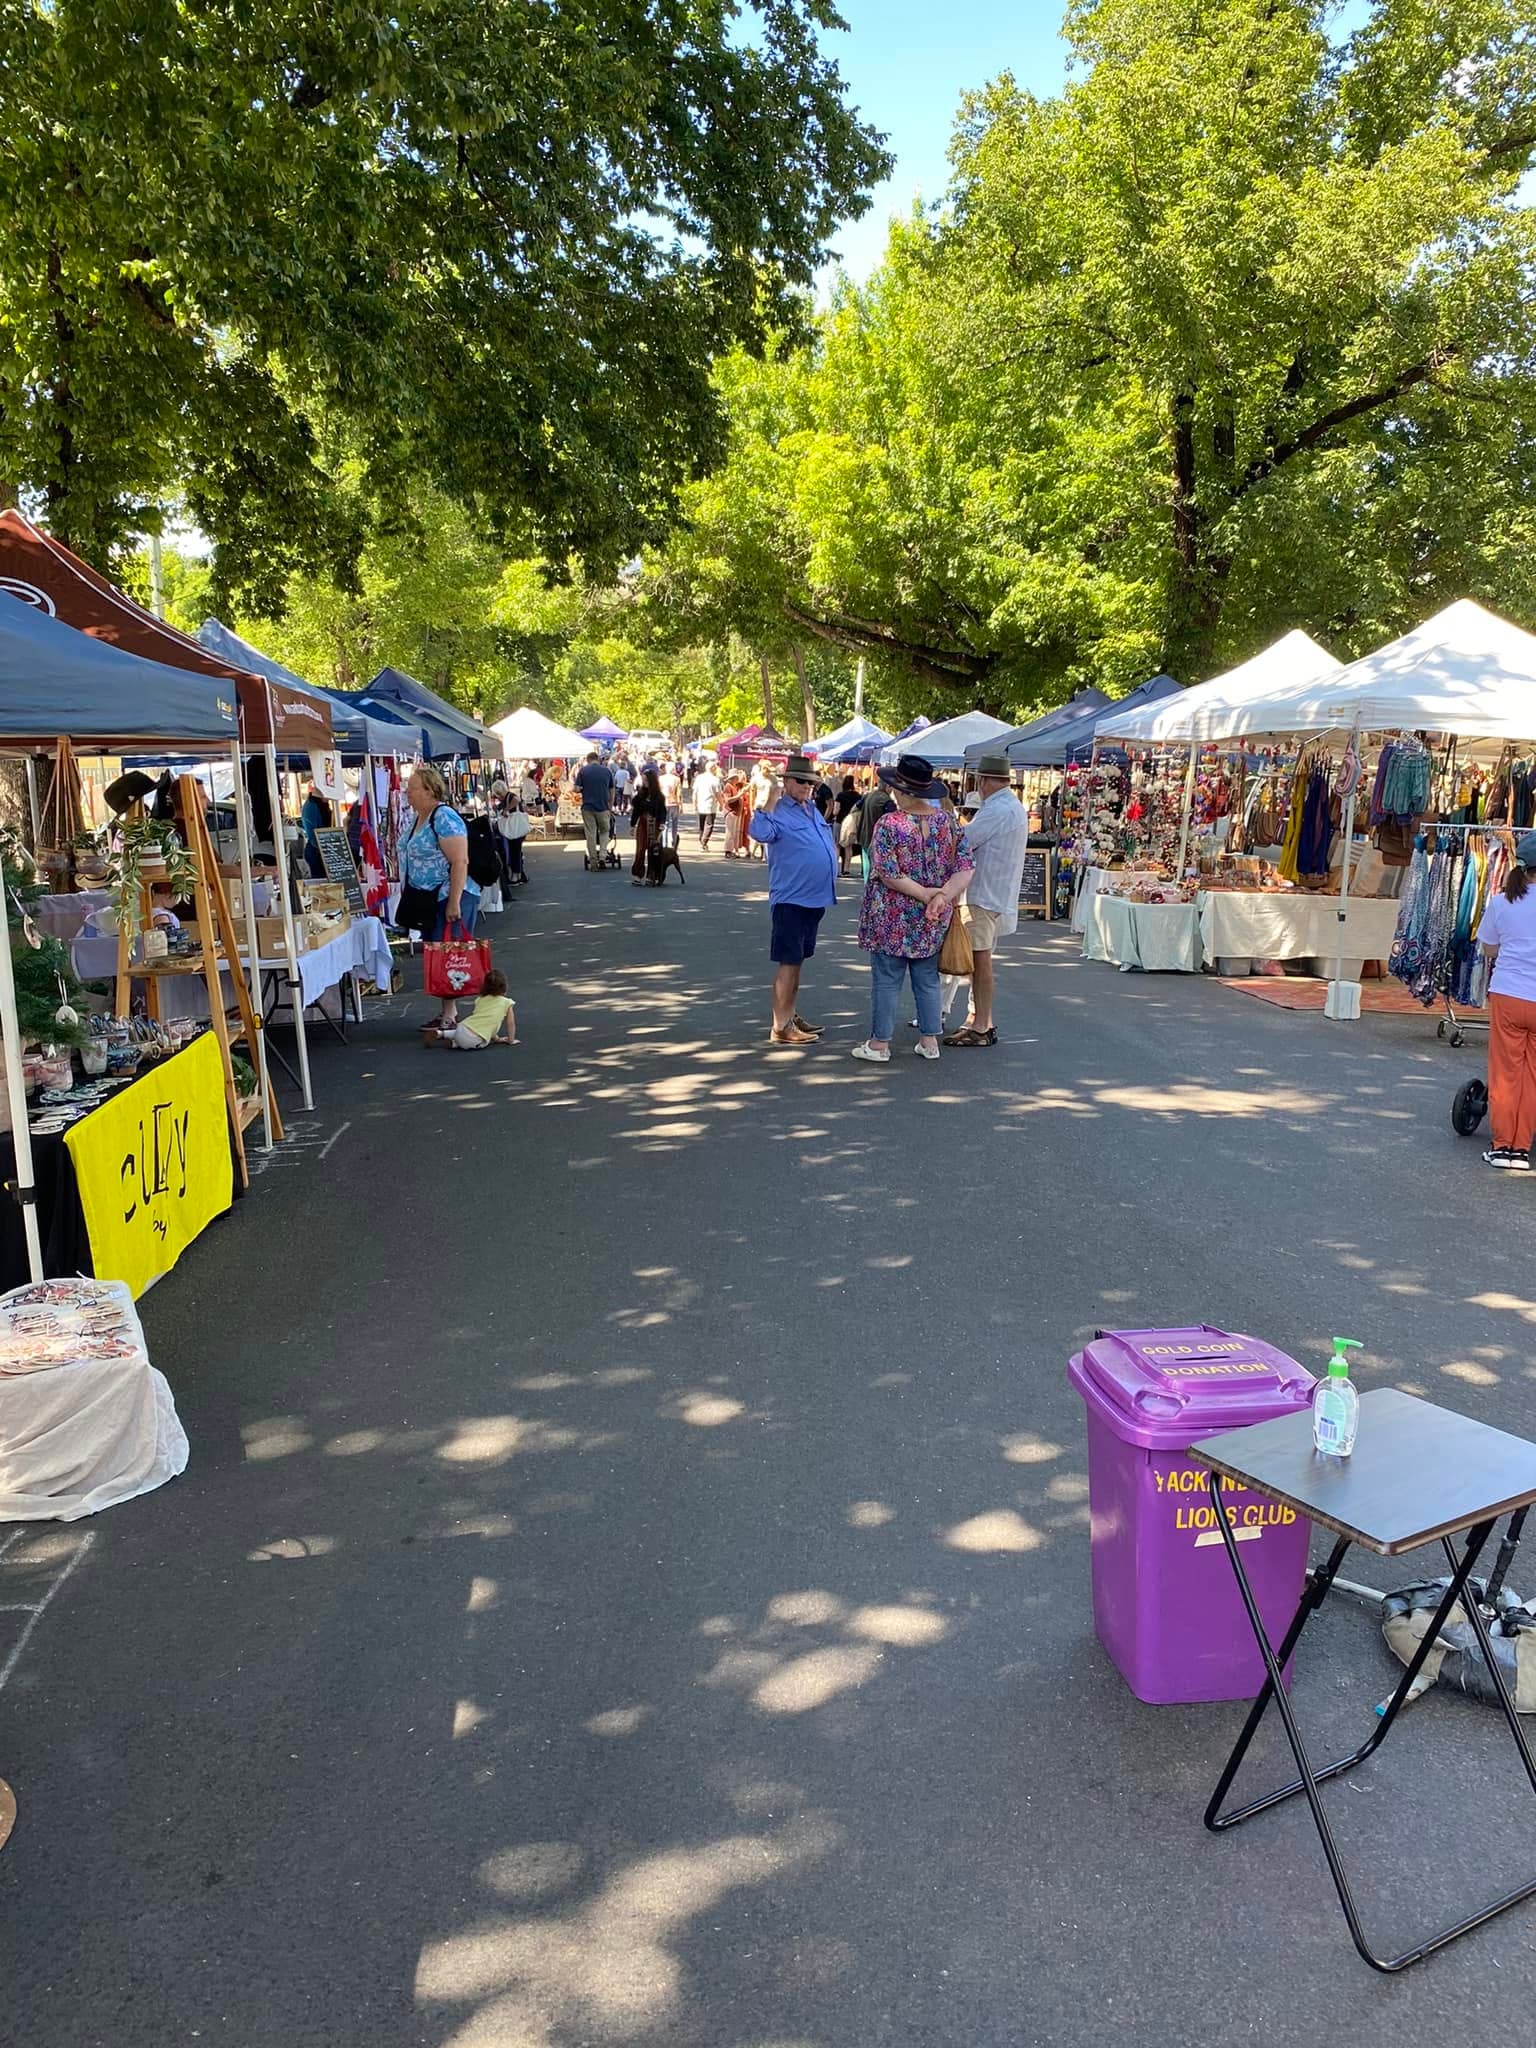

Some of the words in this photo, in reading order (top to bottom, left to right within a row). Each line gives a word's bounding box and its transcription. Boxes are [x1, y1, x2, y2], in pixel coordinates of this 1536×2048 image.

[1142, 1344, 1193, 1355] GOLD
[1197, 1342, 1245, 1353] COIN
[1161, 1363, 1269, 1376] DONATION
[1243, 1503, 1297, 1526] CLUB
